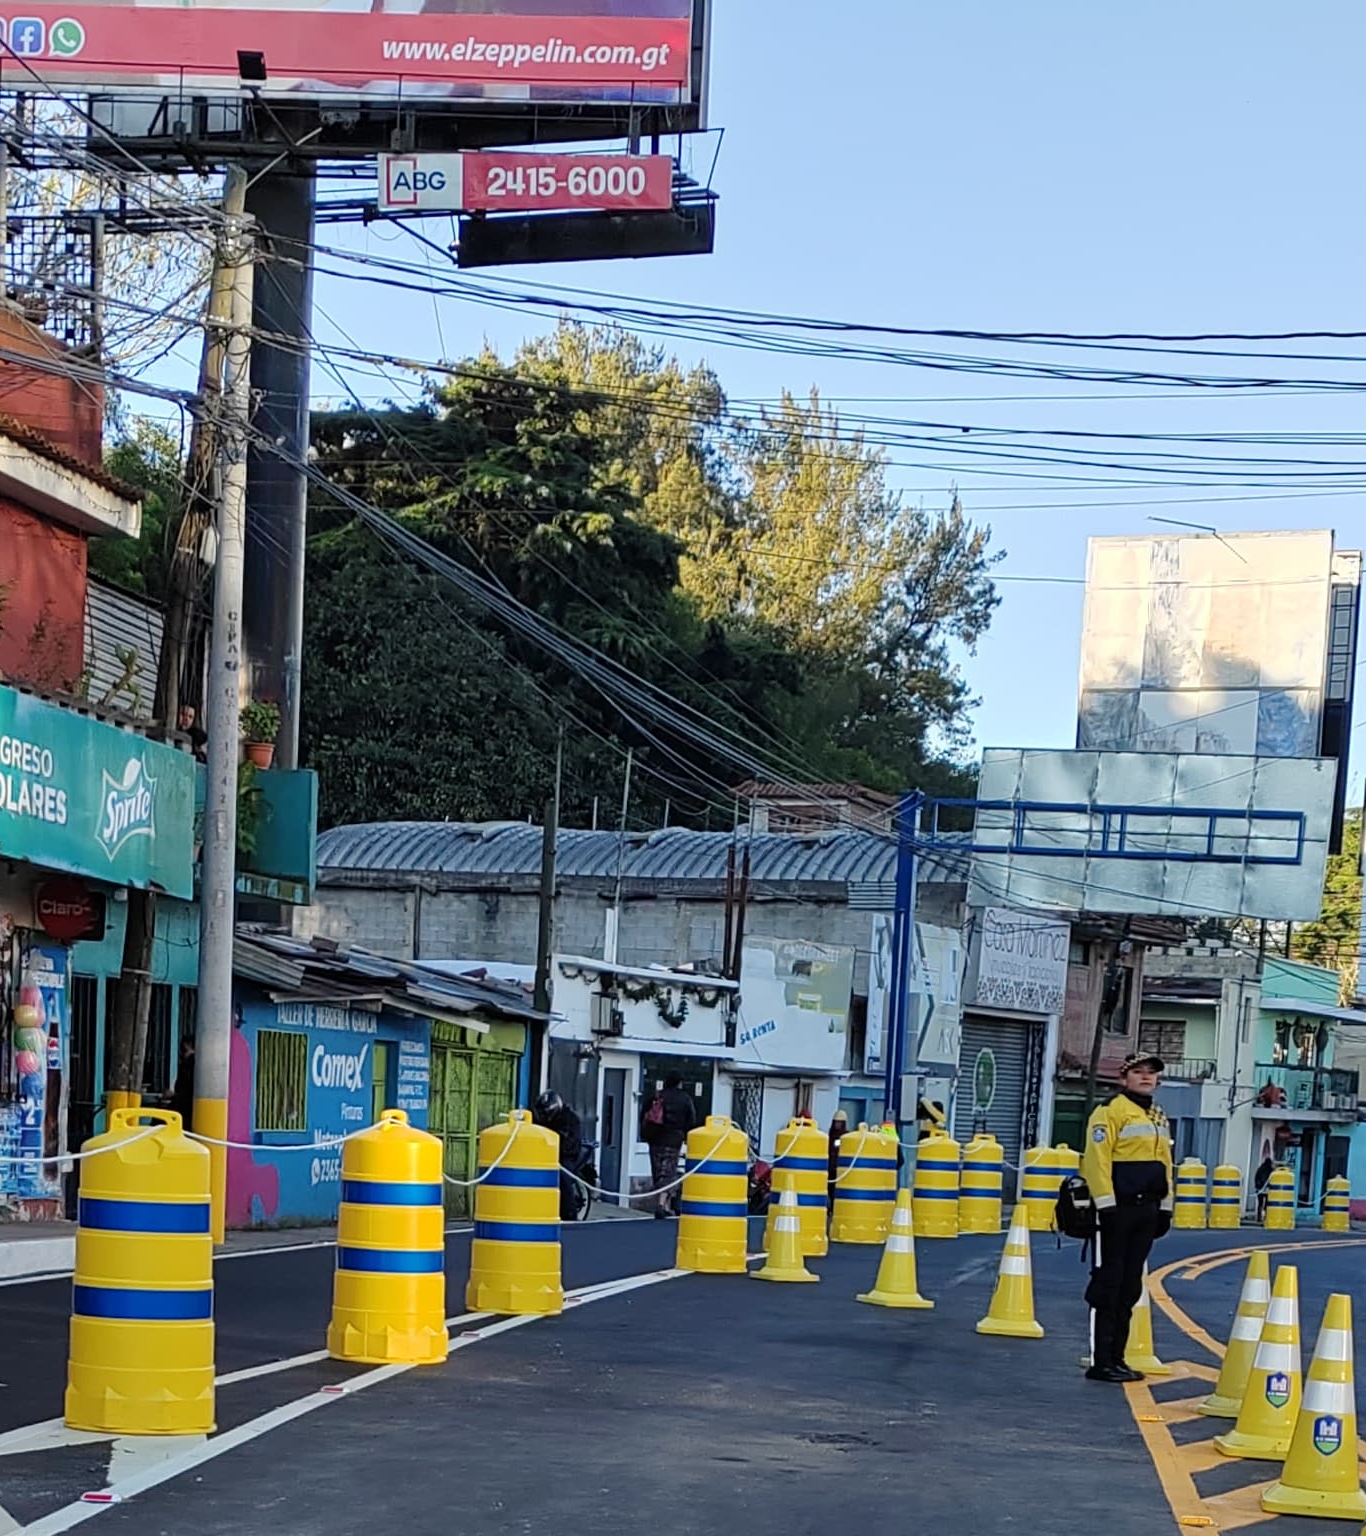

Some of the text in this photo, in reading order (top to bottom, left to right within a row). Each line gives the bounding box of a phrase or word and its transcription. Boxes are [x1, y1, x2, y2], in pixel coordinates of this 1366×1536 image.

[382, 36, 670, 71] www.elzeppelin.com.gt
[392, 164, 647, 198] ABG 2415-6000
[102, 781, 154, 844] Sprite
[39, 898, 84, 917] Claro
[312, 1042, 369, 1093] Comex
